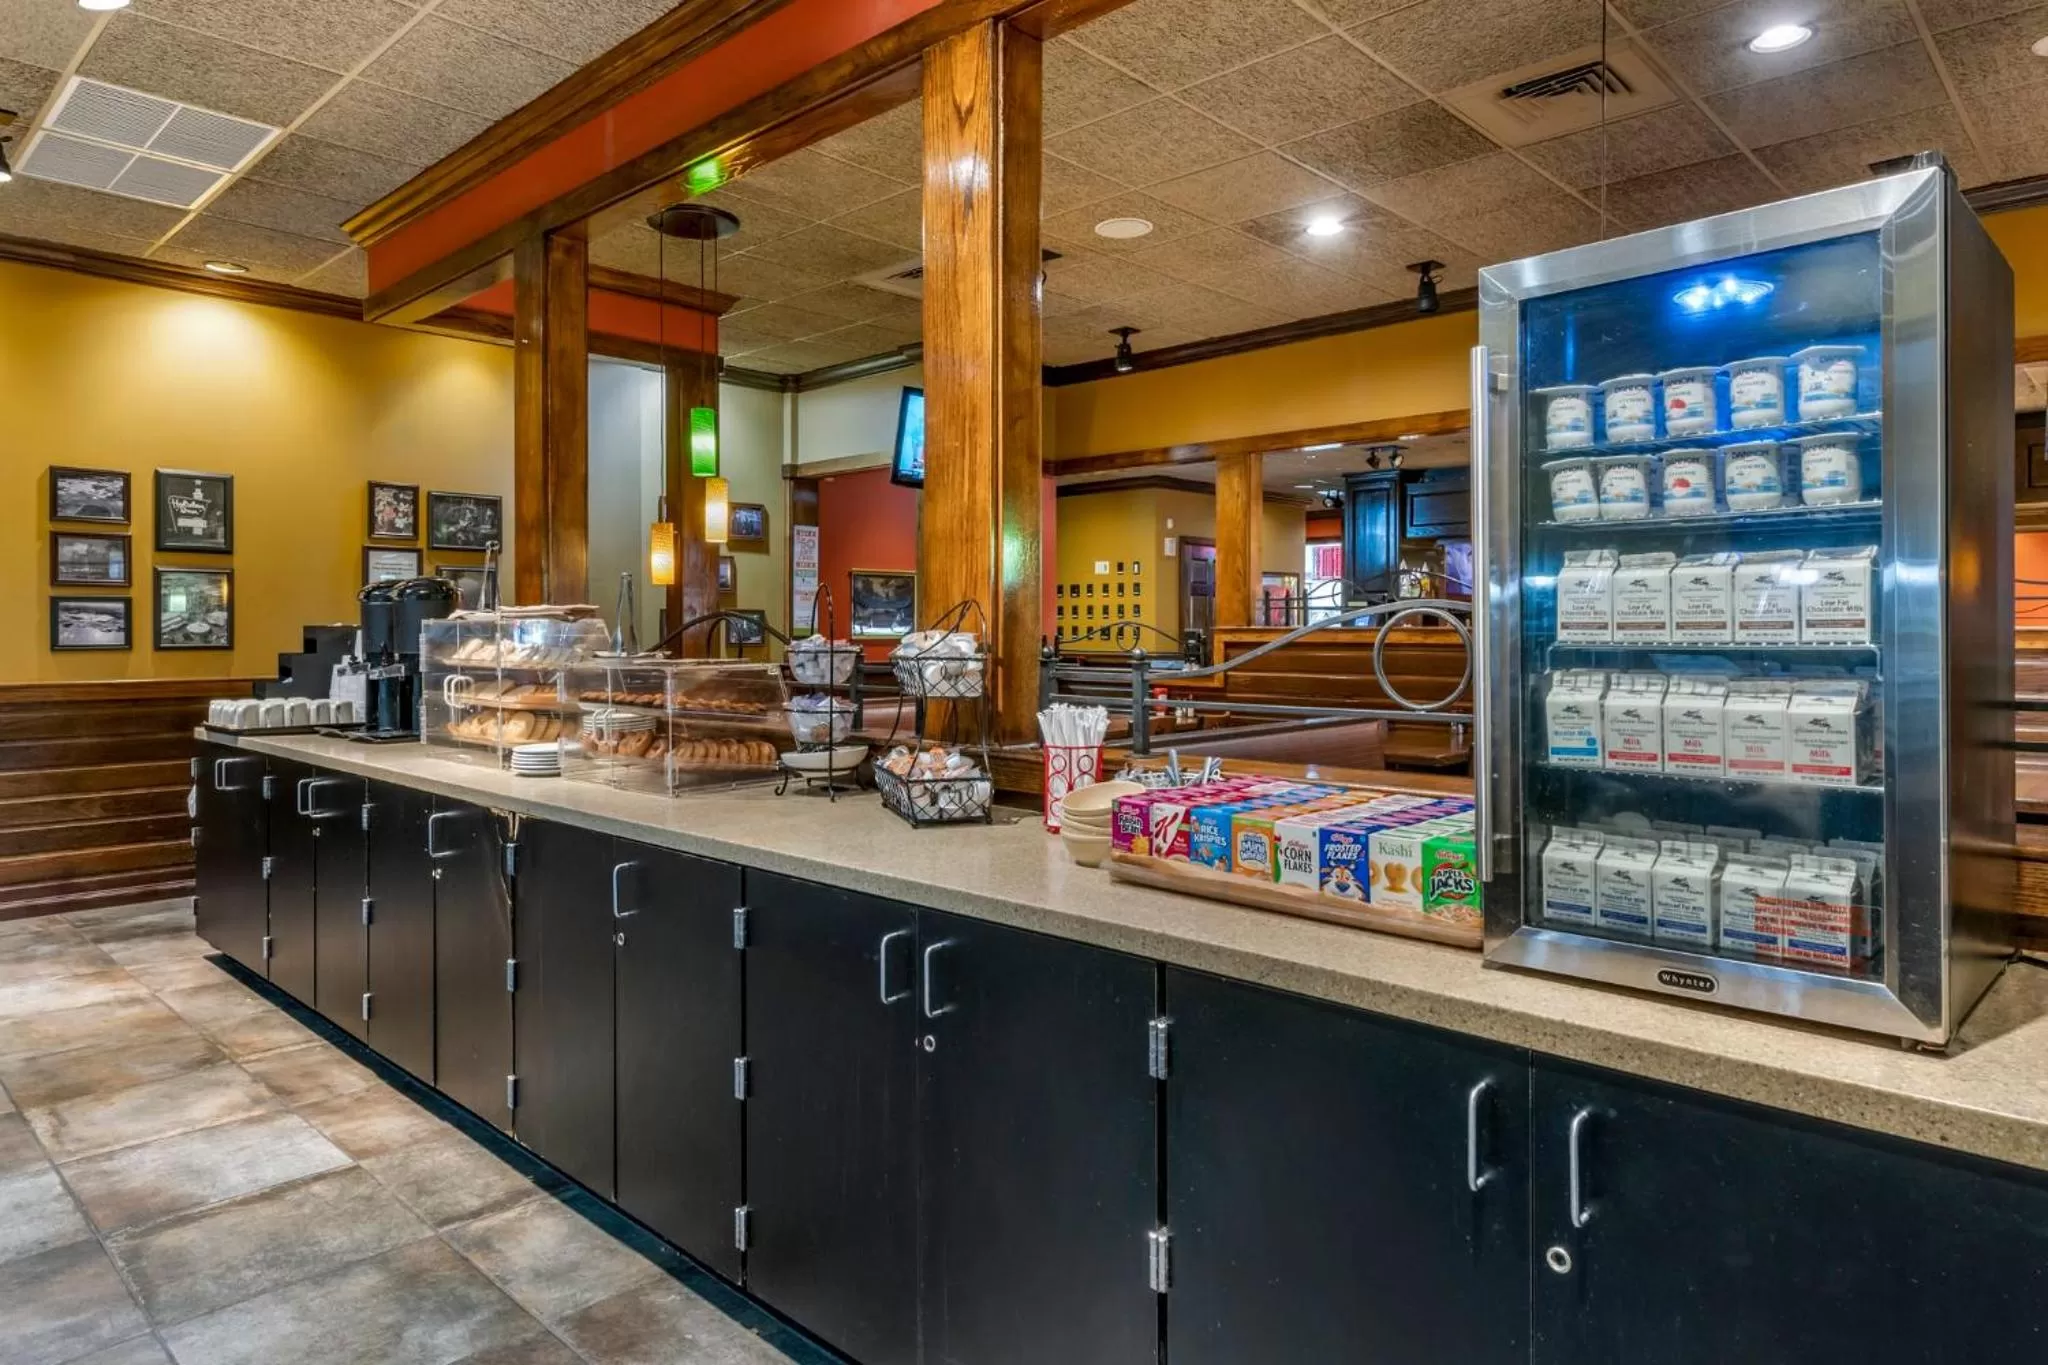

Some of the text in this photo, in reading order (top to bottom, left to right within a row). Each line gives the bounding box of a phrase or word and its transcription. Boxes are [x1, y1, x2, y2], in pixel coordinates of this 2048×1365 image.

[1623, 737, 1640, 746] Milk
[1684, 739, 1703, 748] Milk
[1745, 745, 1765, 754] Milk
[1809, 749, 1831, 759] Milk
[1154, 811, 1179, 844] K
[1200, 824, 1219, 837] RICE
[1283, 846, 1313, 864] CORN
[1323, 843, 1362, 854] FROSTED
[1378, 841, 1413, 859] Kashi
[1326, 851, 1358, 861] FLAKES
[1283, 858, 1314, 875] FLAKES
[1436, 868, 1464, 881] APPLE
[1429, 877, 1475, 901] JACKS
